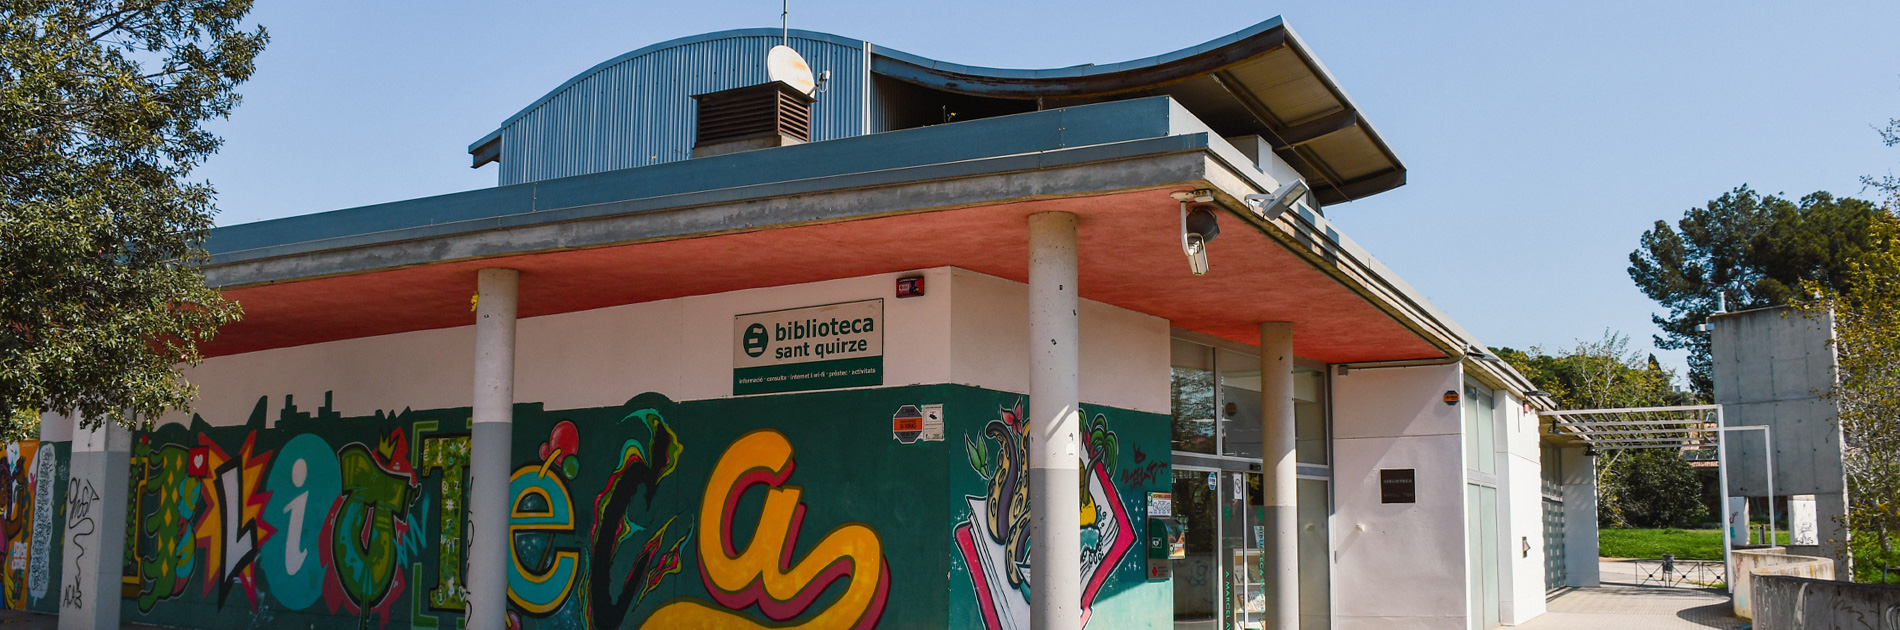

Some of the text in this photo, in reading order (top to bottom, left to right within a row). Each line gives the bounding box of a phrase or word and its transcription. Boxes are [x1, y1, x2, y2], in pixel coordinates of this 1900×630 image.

[775, 317, 874, 341] biblioteca
[775, 338, 868, 359] sant quirze
[851, 367, 876, 375] activitats
